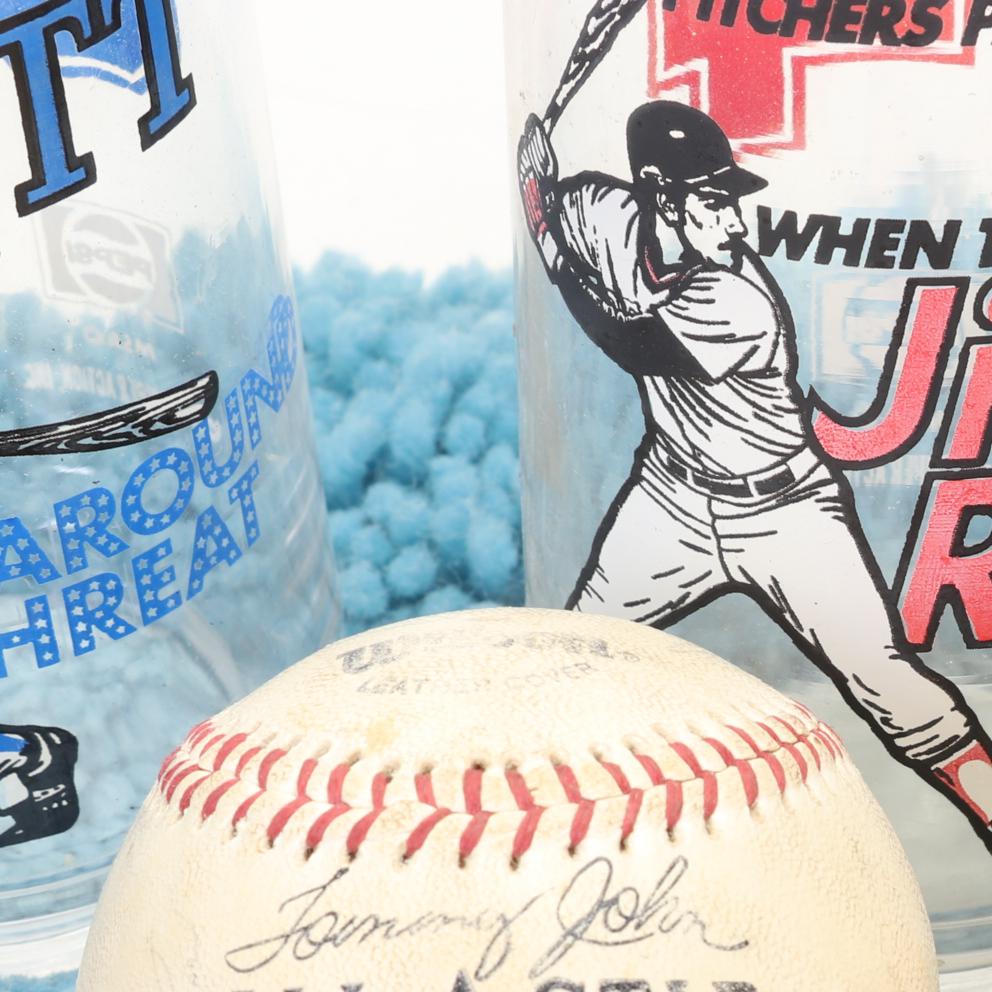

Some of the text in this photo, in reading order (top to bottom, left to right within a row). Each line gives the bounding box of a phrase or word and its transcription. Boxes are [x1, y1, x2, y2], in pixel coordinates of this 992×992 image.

[662, 0, 947, 47] TCHERS
[756, 205, 963, 270] WHEN
[529, 856, 749, 979] John
